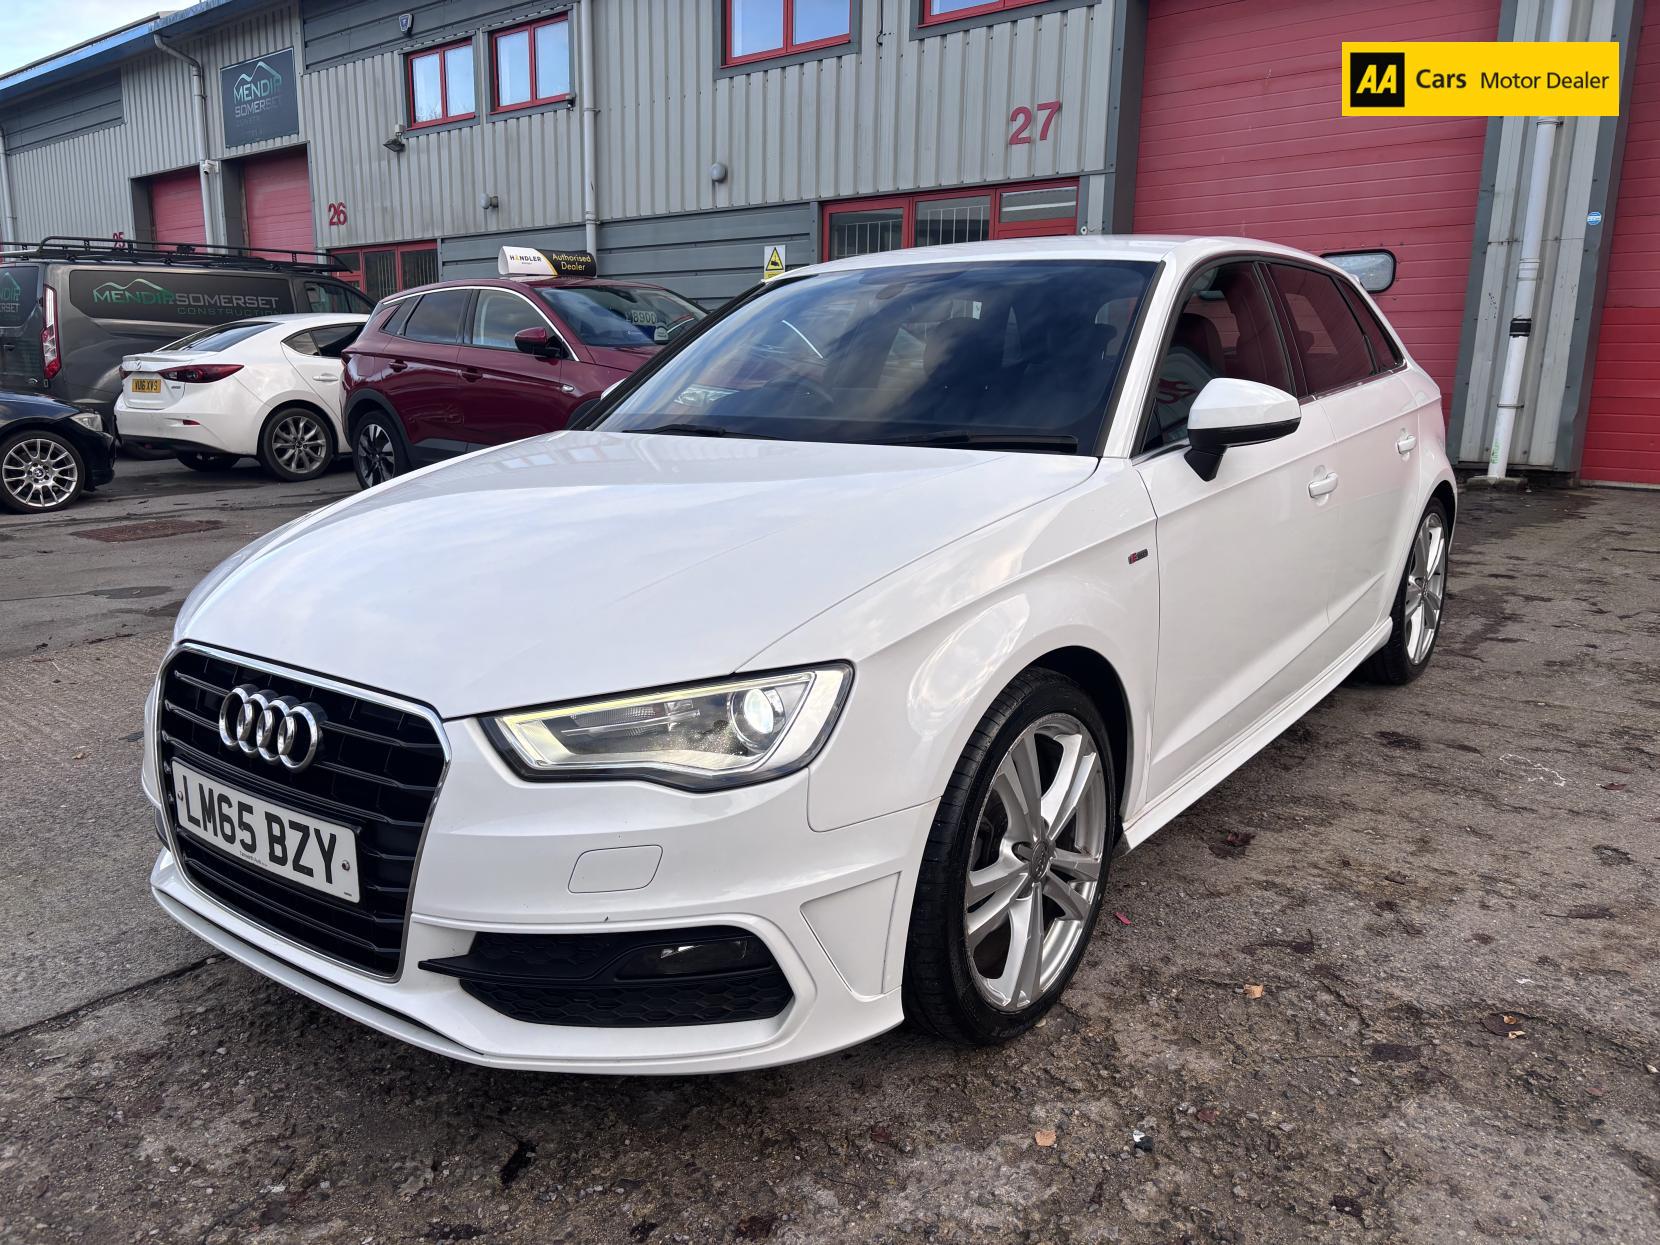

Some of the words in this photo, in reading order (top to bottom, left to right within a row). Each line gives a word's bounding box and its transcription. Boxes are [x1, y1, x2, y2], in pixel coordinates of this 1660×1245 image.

[233, 75, 283, 104] MENDIP
[1009, 100, 1061, 145] 27
[328, 202, 347, 225] 26
[552, 253, 592, 263] Authorised
[561, 261, 586, 271] Dealer
[175, 293, 279, 309] SOMERSET
[182, 775, 257, 854] LM65
[264, 811, 337, 885] BZY
